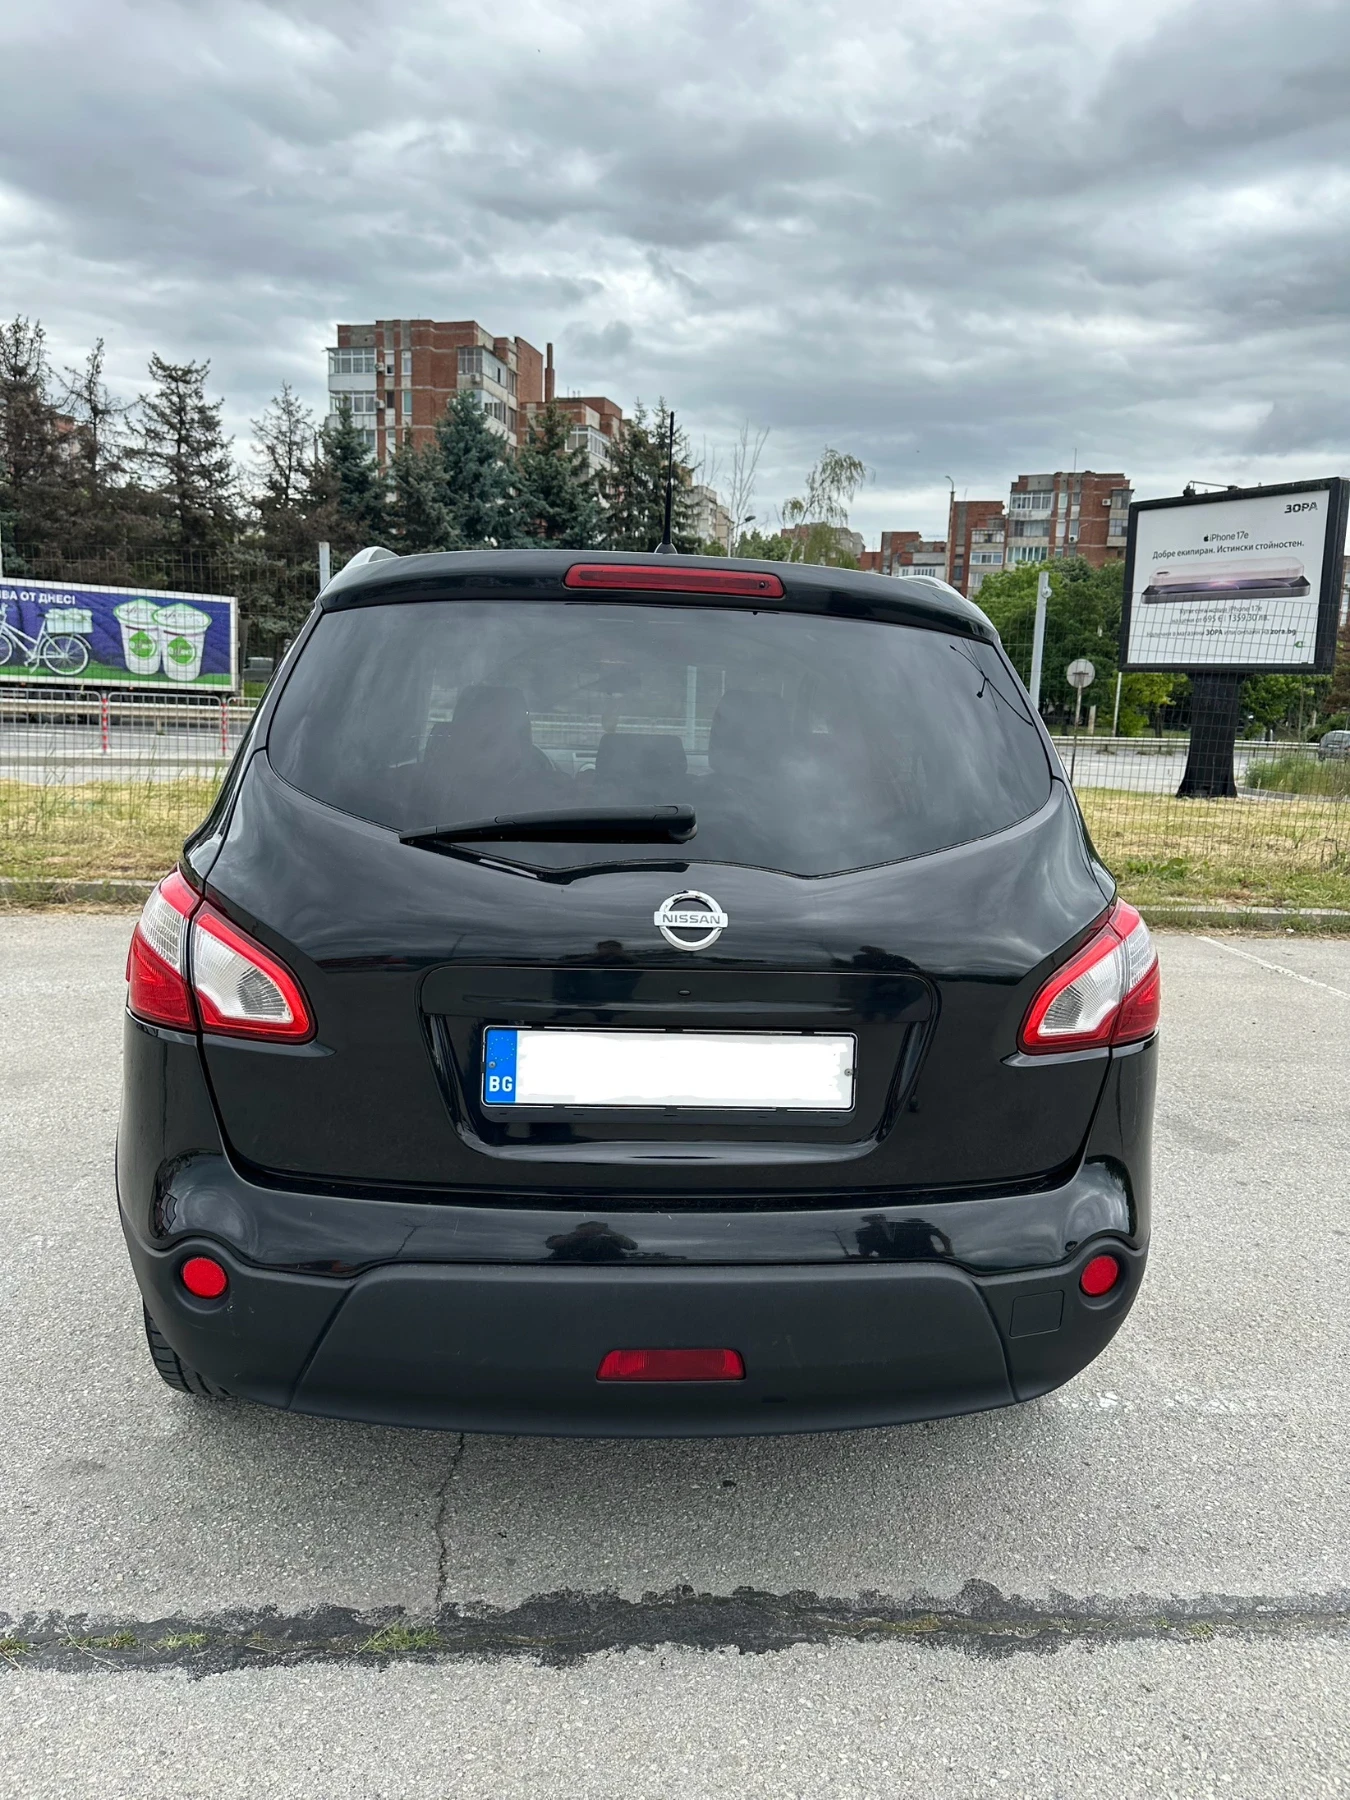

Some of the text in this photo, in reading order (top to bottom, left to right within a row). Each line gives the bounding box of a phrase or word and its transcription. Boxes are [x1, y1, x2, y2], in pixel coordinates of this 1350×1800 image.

[1284, 502, 1318, 514] ЗОРА
[1210, 531, 1249, 542] iPhone 17e
[1152, 539, 1304, 560] Добре екипиран. Истински стойностен.
[0, 590, 18, 600] ВА
[20, 591, 37, 602] ОТ
[1229, 605, 1250, 613] iPhone
[1203, 614, 1216, 623] 695
[1205, 628, 1222, 636] ЗОРА
[1270, 627, 1297, 636] zora.bg
[662, 913, 721, 925] NISSAN
[489, 1075, 513, 1093] BG
